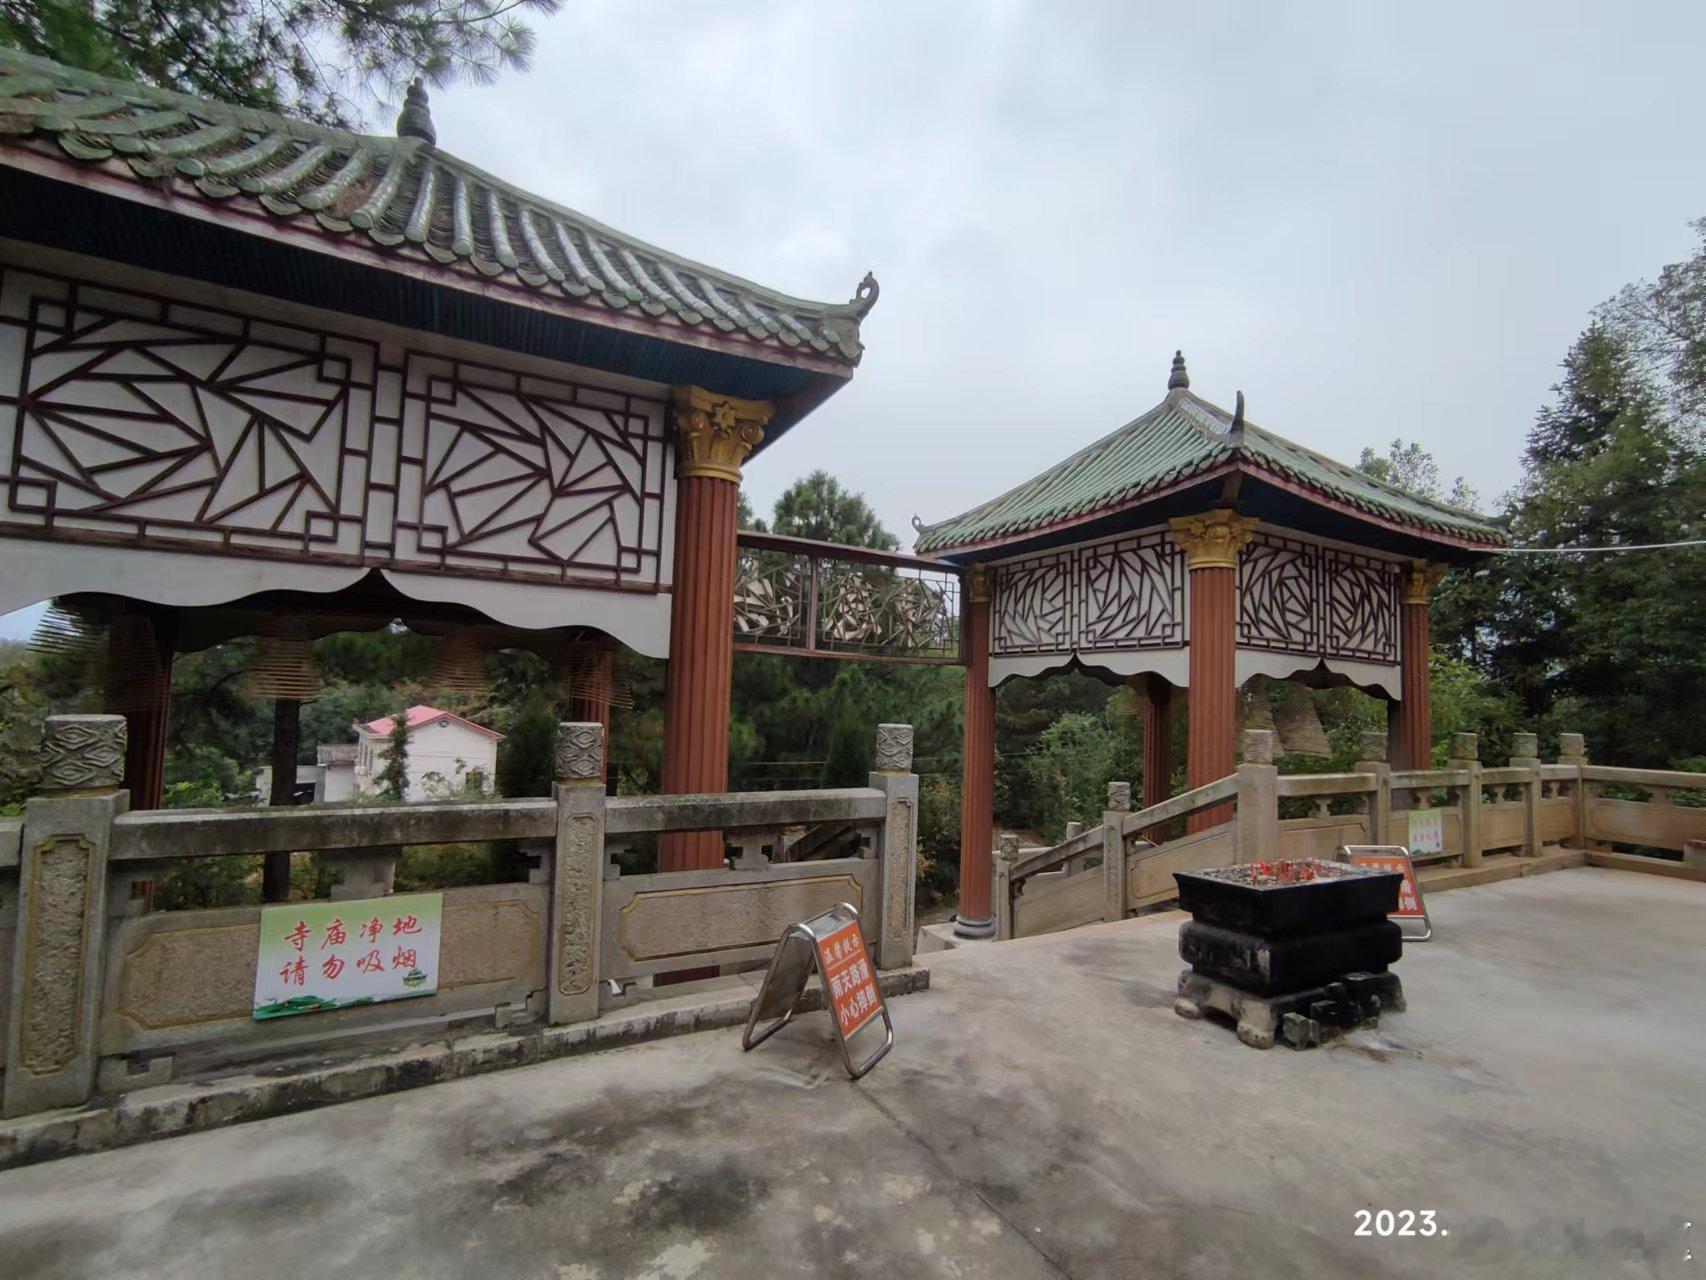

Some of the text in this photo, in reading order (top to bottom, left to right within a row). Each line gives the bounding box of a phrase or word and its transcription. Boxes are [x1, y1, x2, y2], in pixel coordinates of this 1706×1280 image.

[284, 915, 422, 952] 寺庙净地
[279, 946, 417, 987] 请勿吸烟
